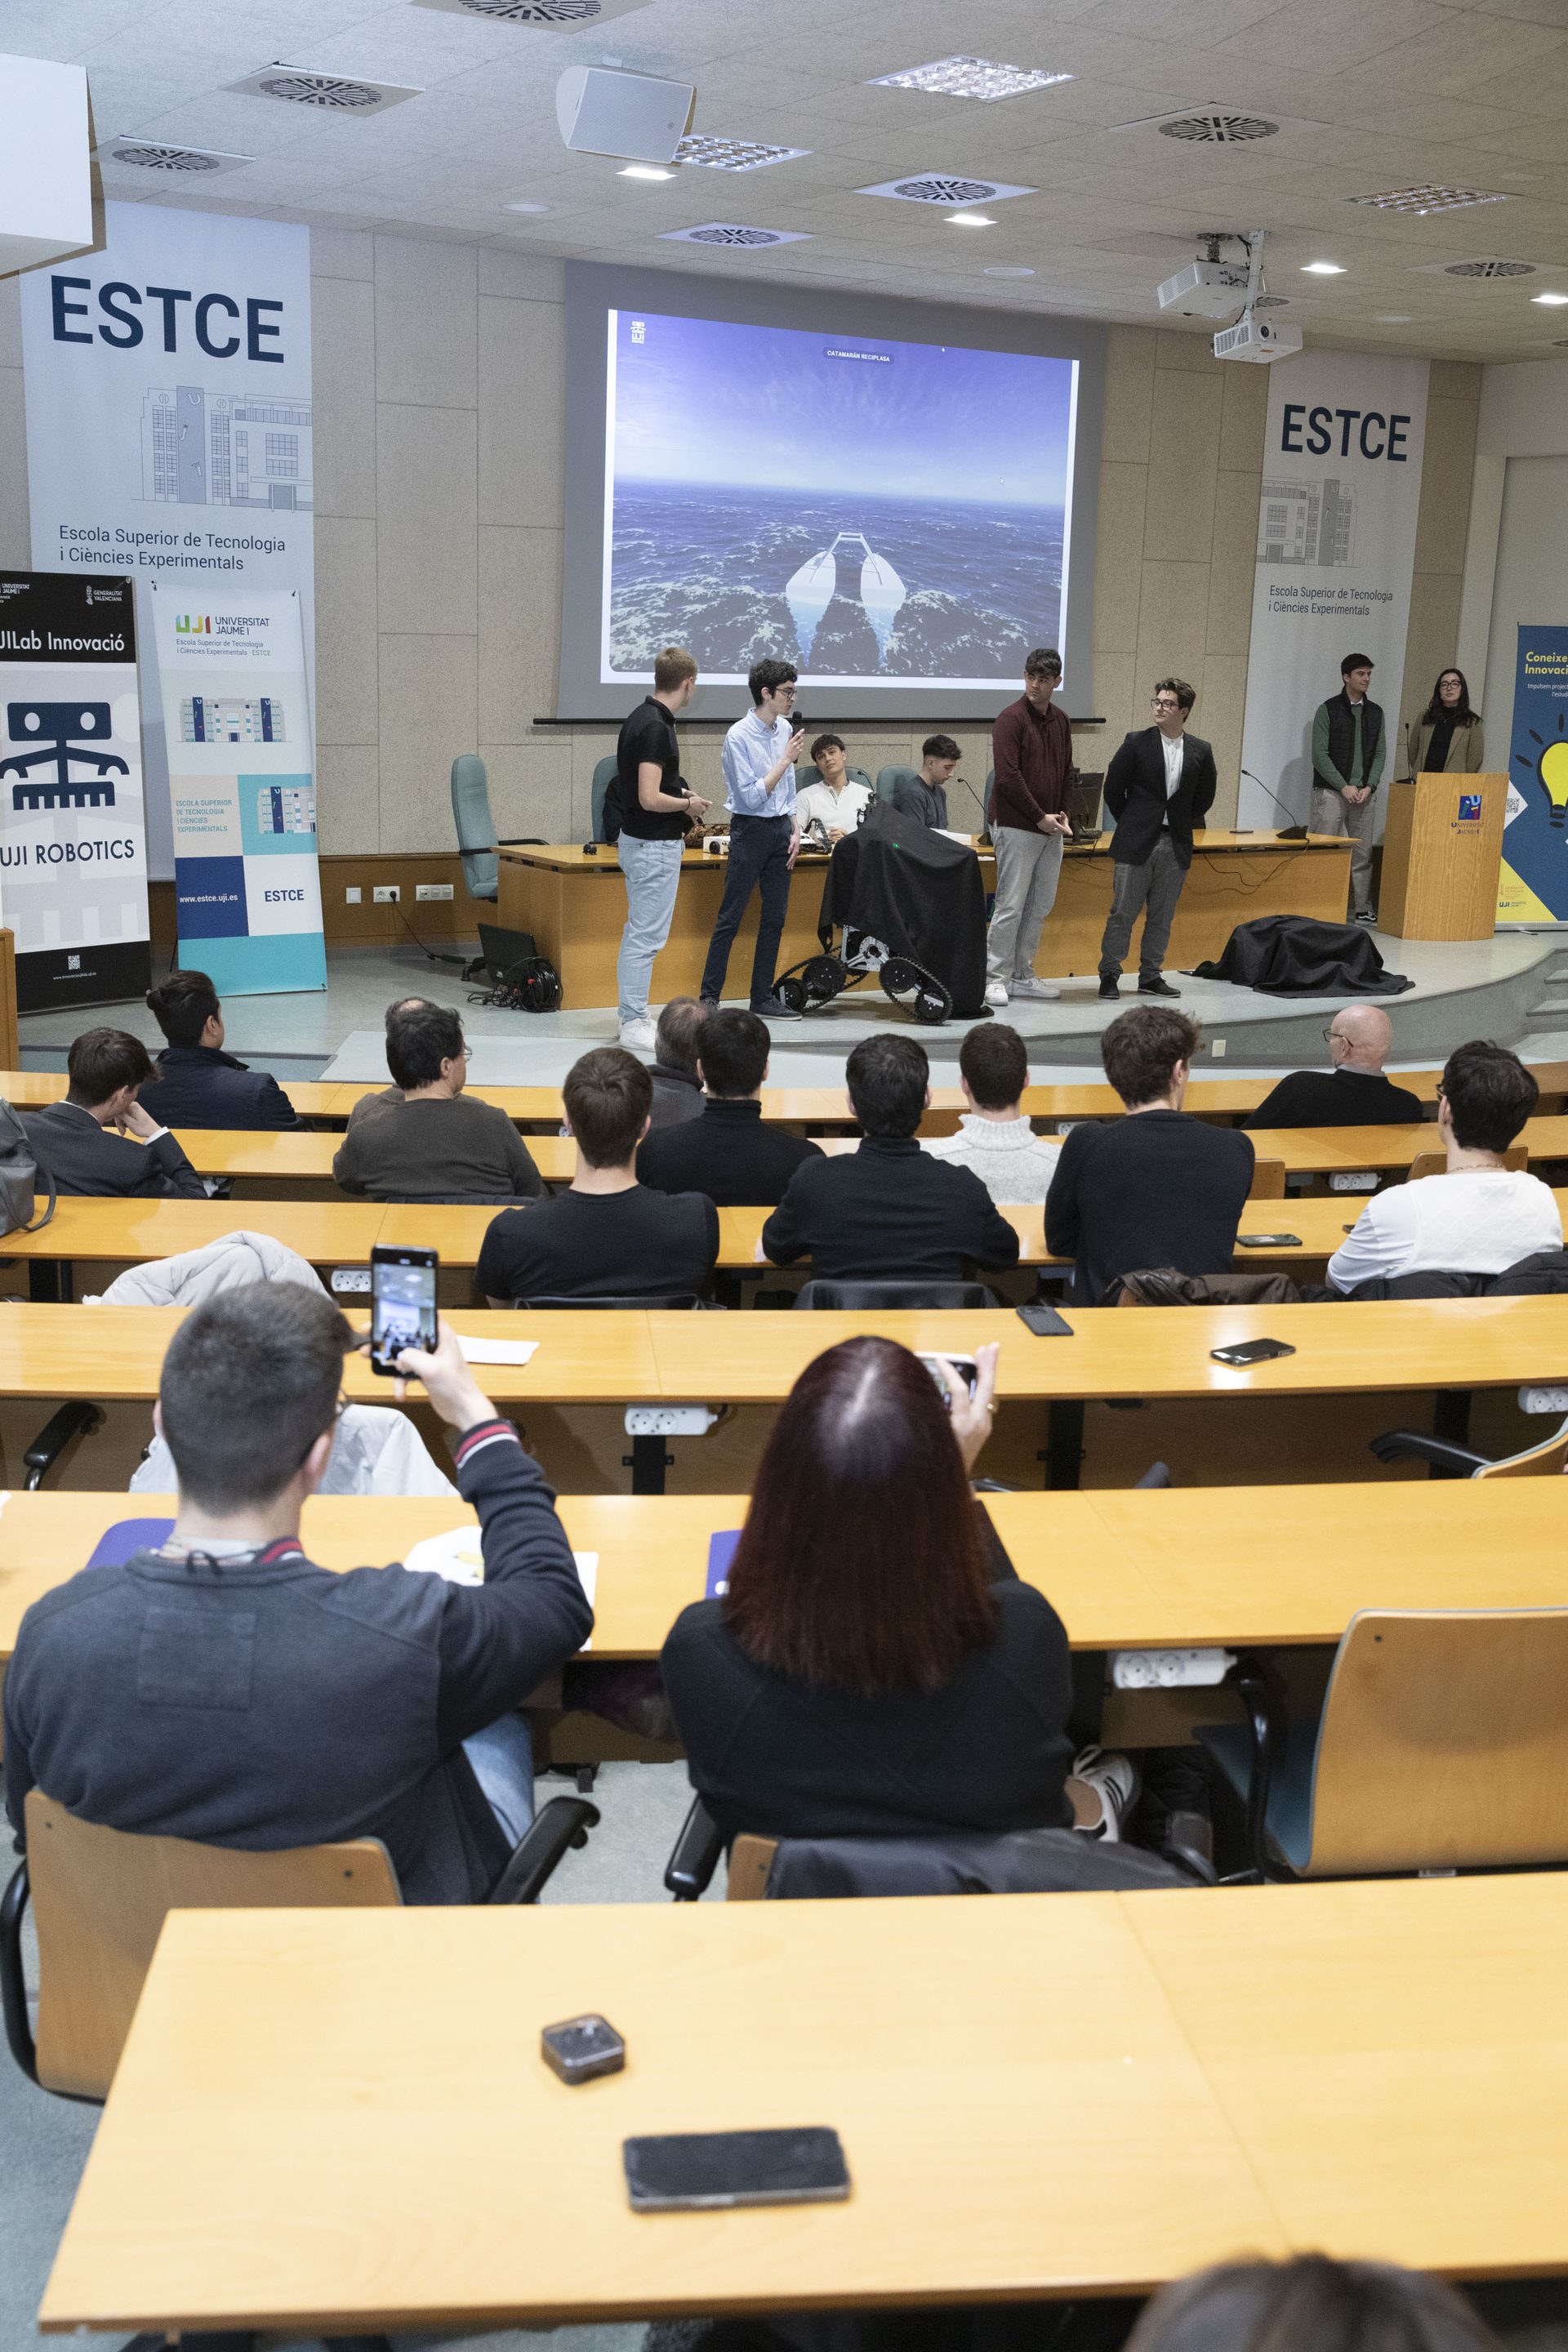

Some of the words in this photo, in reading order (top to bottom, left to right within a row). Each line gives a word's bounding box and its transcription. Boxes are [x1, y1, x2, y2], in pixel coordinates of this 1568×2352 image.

[51, 274, 285, 363] ESTCE
[827, 350, 861, 359] CATAMARÁN
[861, 354, 890, 363] RECIPLASA
[1281, 403, 1411, 462] ESTCE
[59, 525, 110, 542] Escola
[115, 528, 179, 547] Superior
[183, 532, 202, 547] de
[206, 533, 286, 555] Tecnologia
[60, 546, 65, 562] i
[69, 547, 135, 565] Ciències
[139, 551, 244, 571] Experimentals
[1269, 585, 1298, 597] Escola
[1300, 586, 1336, 600] Superior
[1338, 588, 1348, 599] de
[1350, 589, 1393, 604] Tecnologia
[1268, 600, 1272, 612] i
[1273, 601, 1309, 613] Ciències
[1311, 603, 1370, 616] Experimentals
[215, 617, 270, 626] UNIVERSITAT
[216, 626, 245, 635] JAUME
[247, 627, 250, 635] I
[0, 630, 42, 650] JILab
[47, 631, 125, 651] Innovació
[176, 638, 197, 646] Escola
[197, 639, 222, 648] Superior
[232, 640, 264, 649] Tecnologia
[1526, 651, 1568, 662] Coneixe
[1525, 663, 1568, 675] Innovaci
[0, 845, 28, 867] UJI
[35, 839, 135, 864] ROBOTICS
[179, 893, 238, 903] www.estce.uji.es
[264, 889, 305, 902] ESTCE
